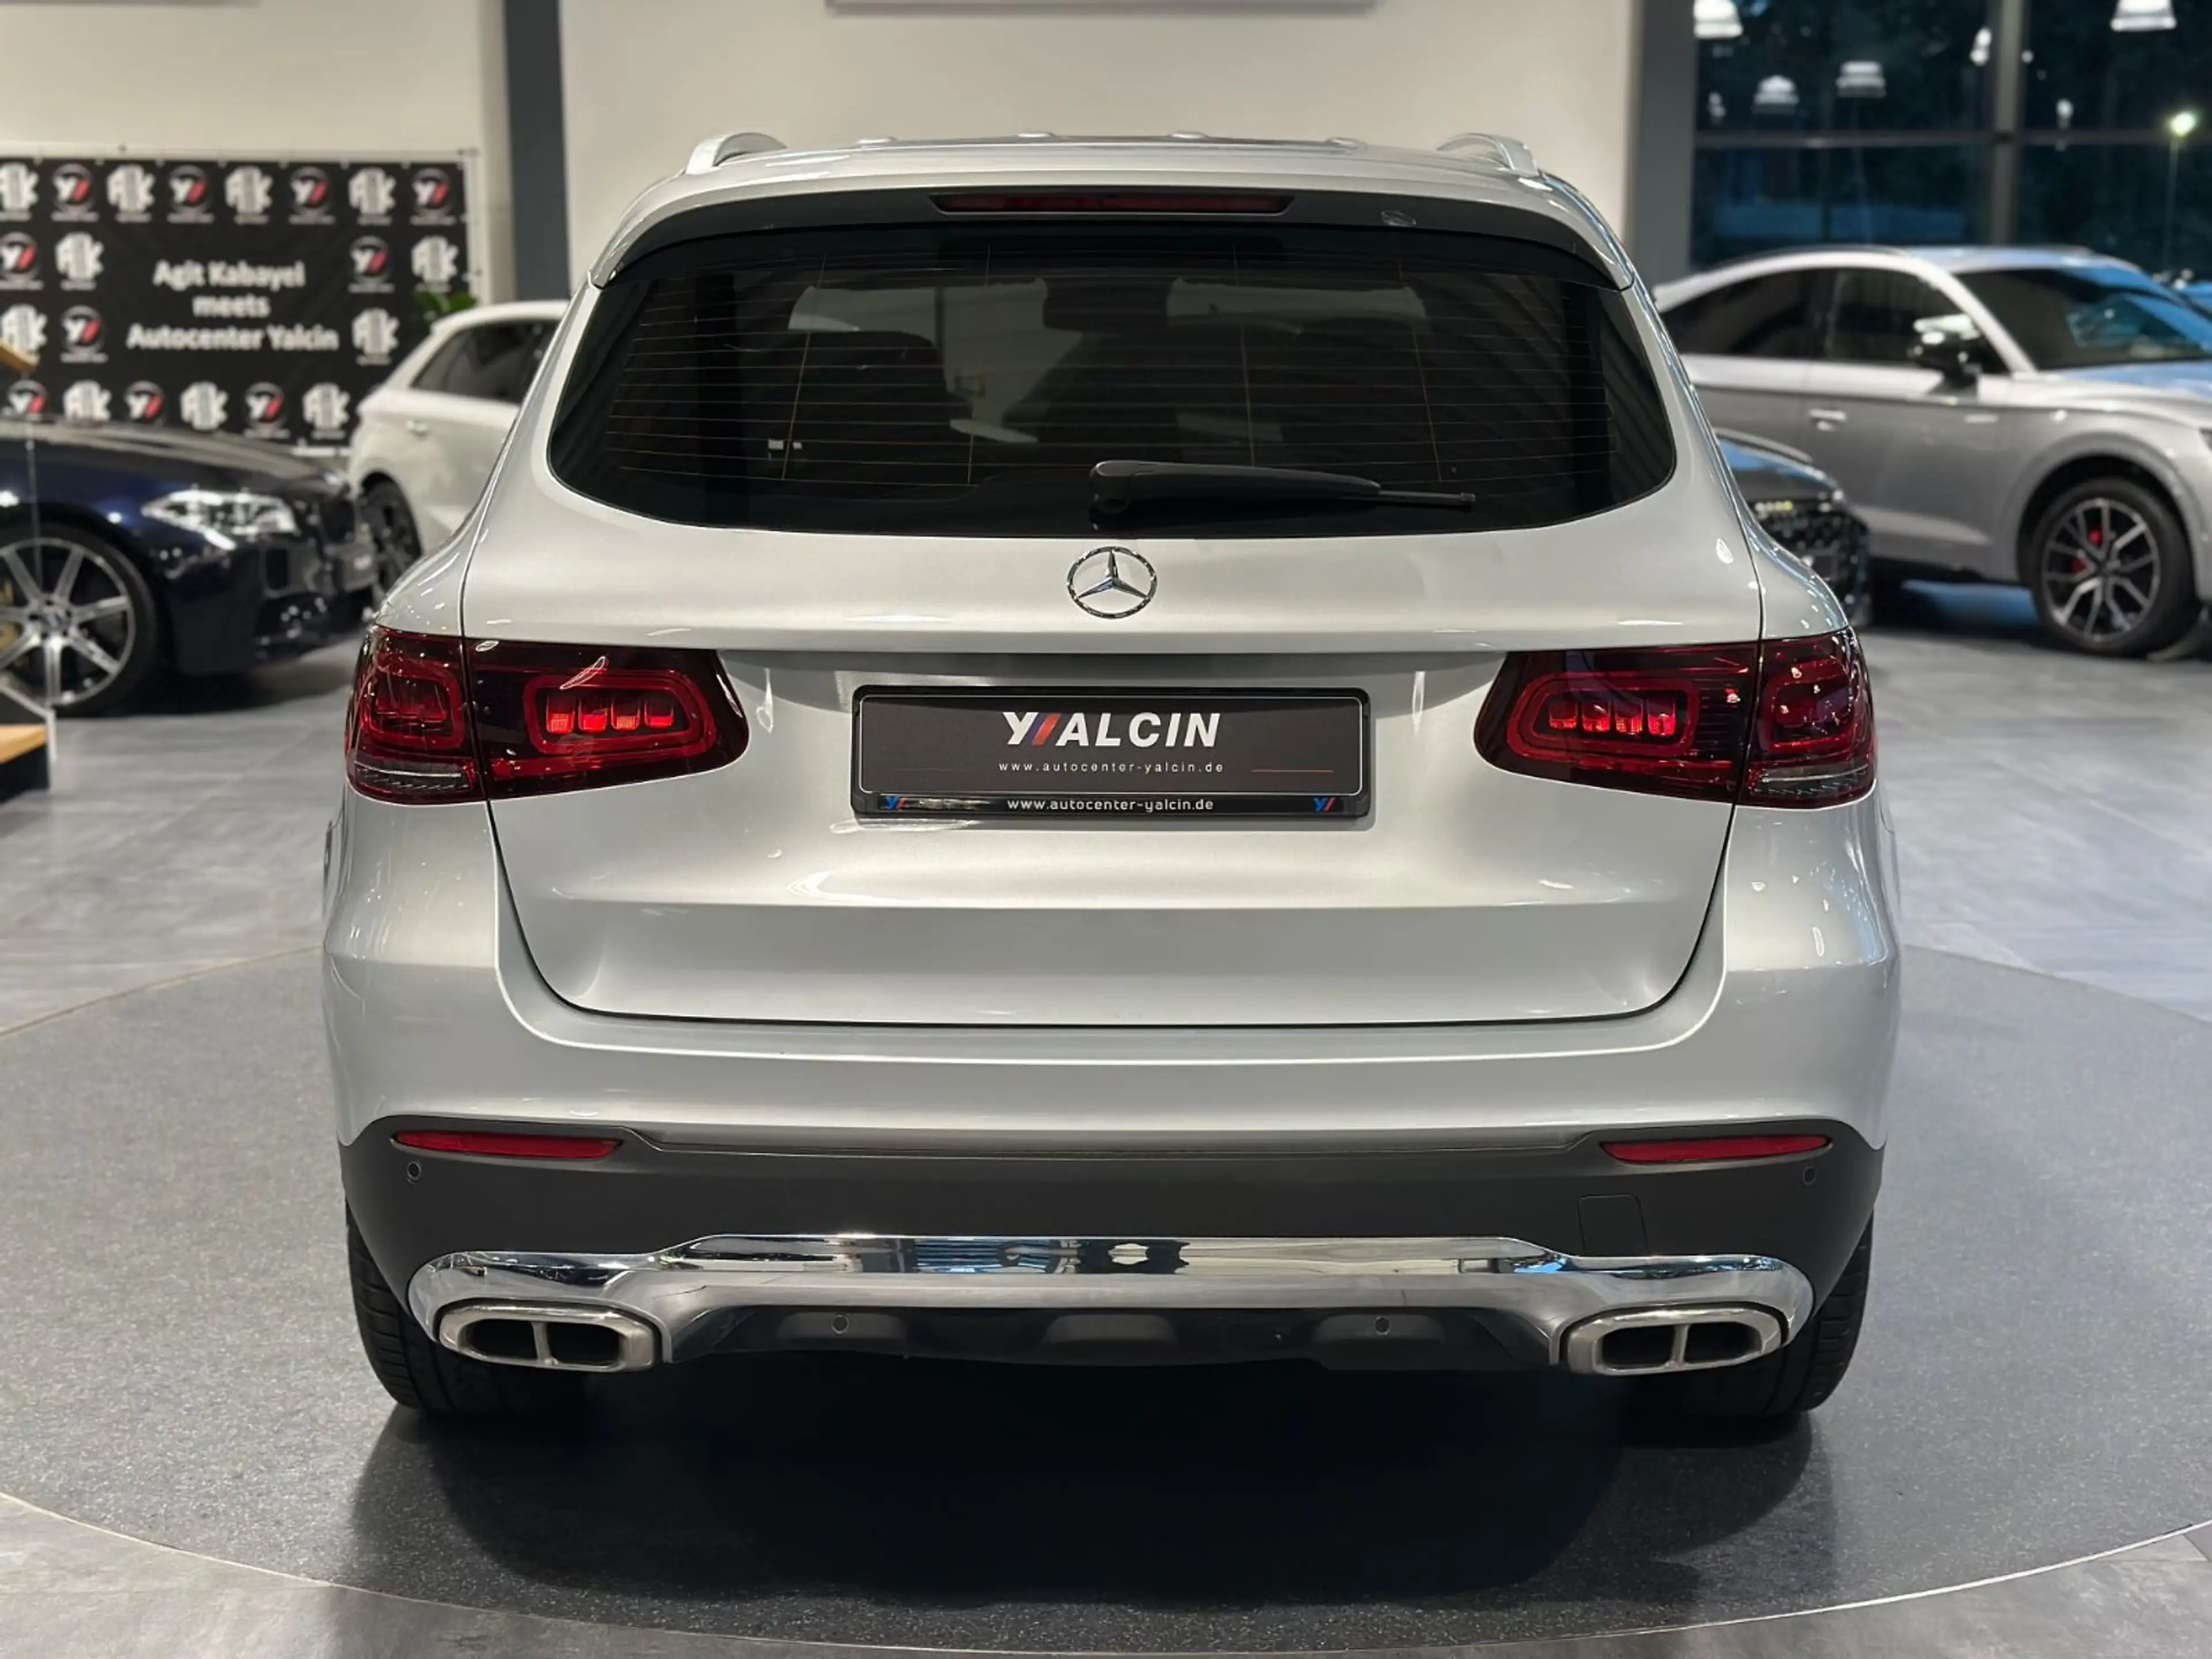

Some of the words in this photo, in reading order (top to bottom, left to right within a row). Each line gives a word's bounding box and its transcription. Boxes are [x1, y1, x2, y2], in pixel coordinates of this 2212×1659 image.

[153, 260, 206, 291] Agit
[208, 260, 305, 291] Kabayel
[192, 294, 271, 317] meets
[126, 323, 264, 350] Autocenter
[998, 761, 1224, 774] www.autocenter-yalcin.de
[1007, 798, 1214, 813] www.autocenter-yalcin.de
